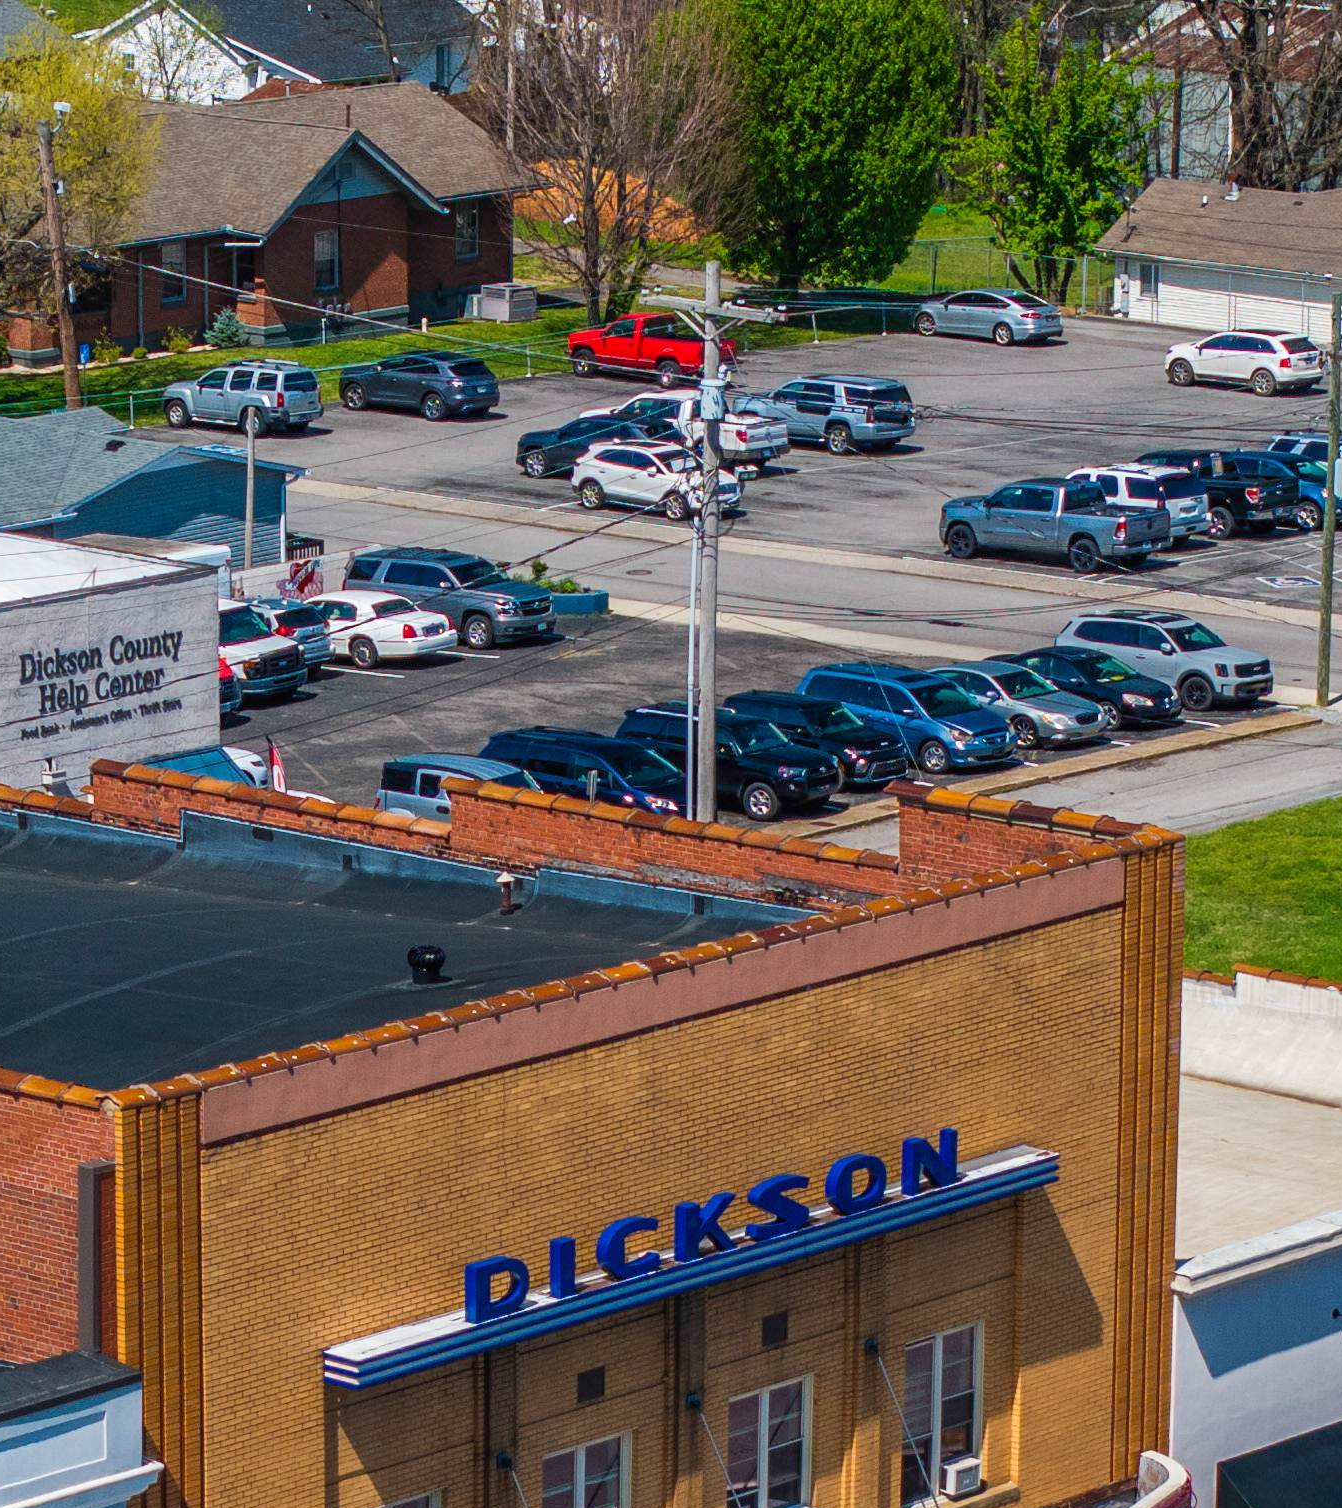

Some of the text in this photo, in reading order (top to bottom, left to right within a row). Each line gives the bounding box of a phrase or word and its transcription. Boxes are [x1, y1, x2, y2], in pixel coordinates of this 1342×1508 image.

[19, 630, 183, 685] Dickson County
[39, 666, 165, 714] Help Center
[465, 1127, 959, 1324] DICKSON
